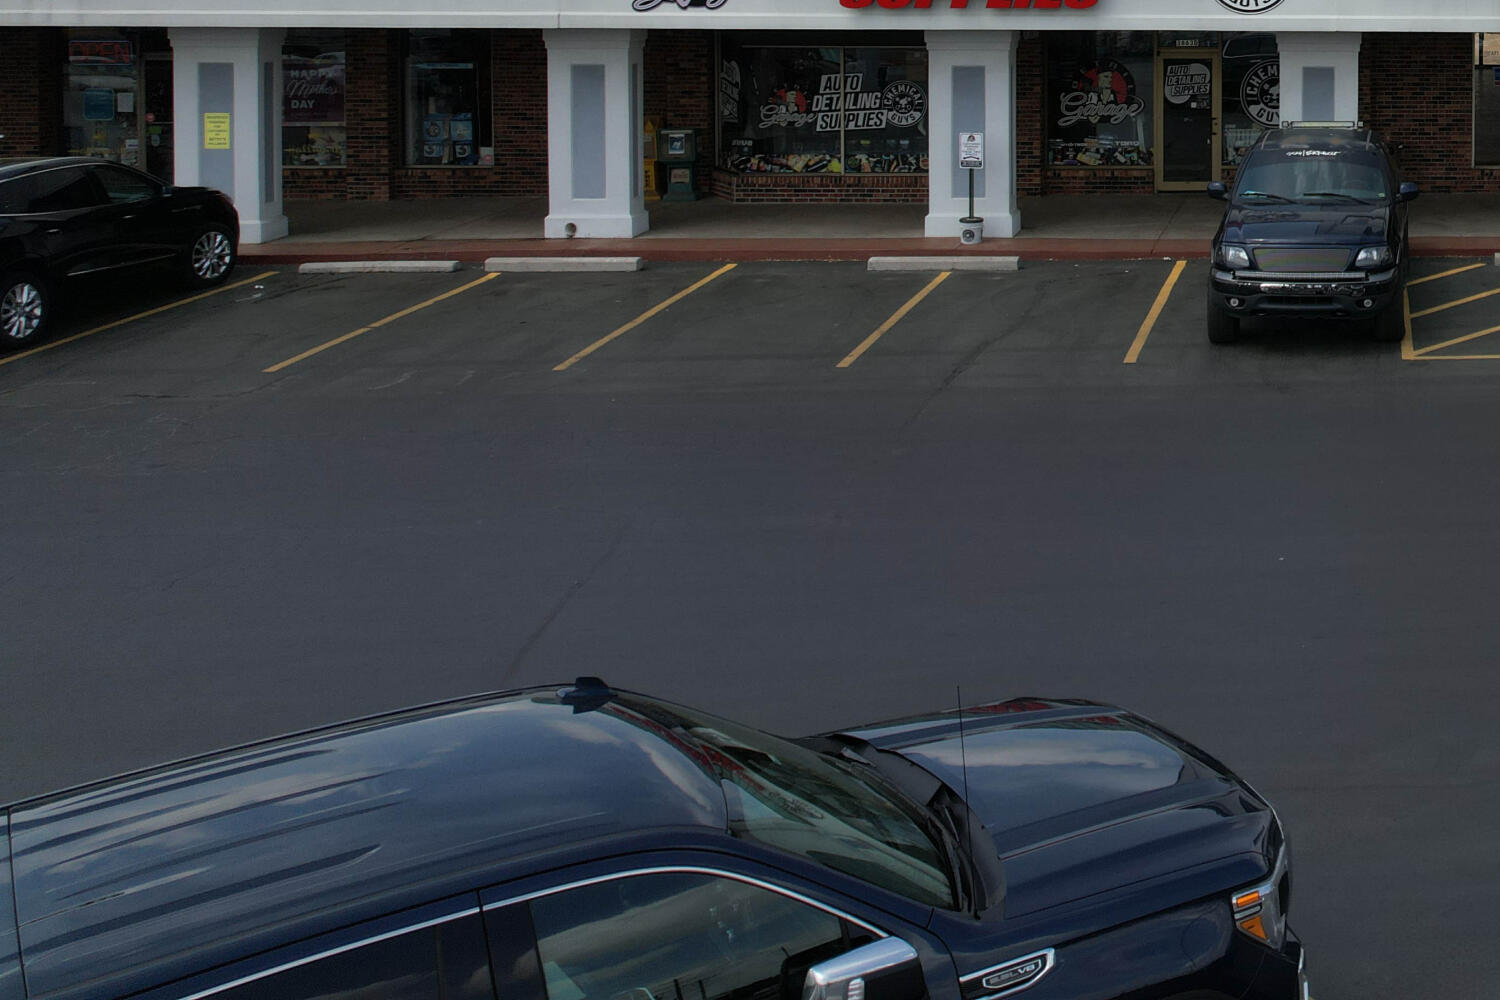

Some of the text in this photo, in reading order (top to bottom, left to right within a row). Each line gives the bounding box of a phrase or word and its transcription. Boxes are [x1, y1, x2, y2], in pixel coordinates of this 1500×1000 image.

[1168, 65, 1189, 75] AUTO
[822, 75, 860, 92] AUTO
[1167, 74, 1206, 86] DETAILING
[1246, 65, 1280, 95] CHEM
[884, 84, 924, 105] CHEMICAL
[1173, 85, 1209, 96] SUPPLIES
[291, 99, 315, 109] DAY
[812, 92, 882, 112] DETAILING
[1058, 91, 1145, 126] Garage
[758, 104, 818, 128] Garage
[819, 111, 884, 130] SUPPLIES
[890, 112, 916, 124] GUYS
